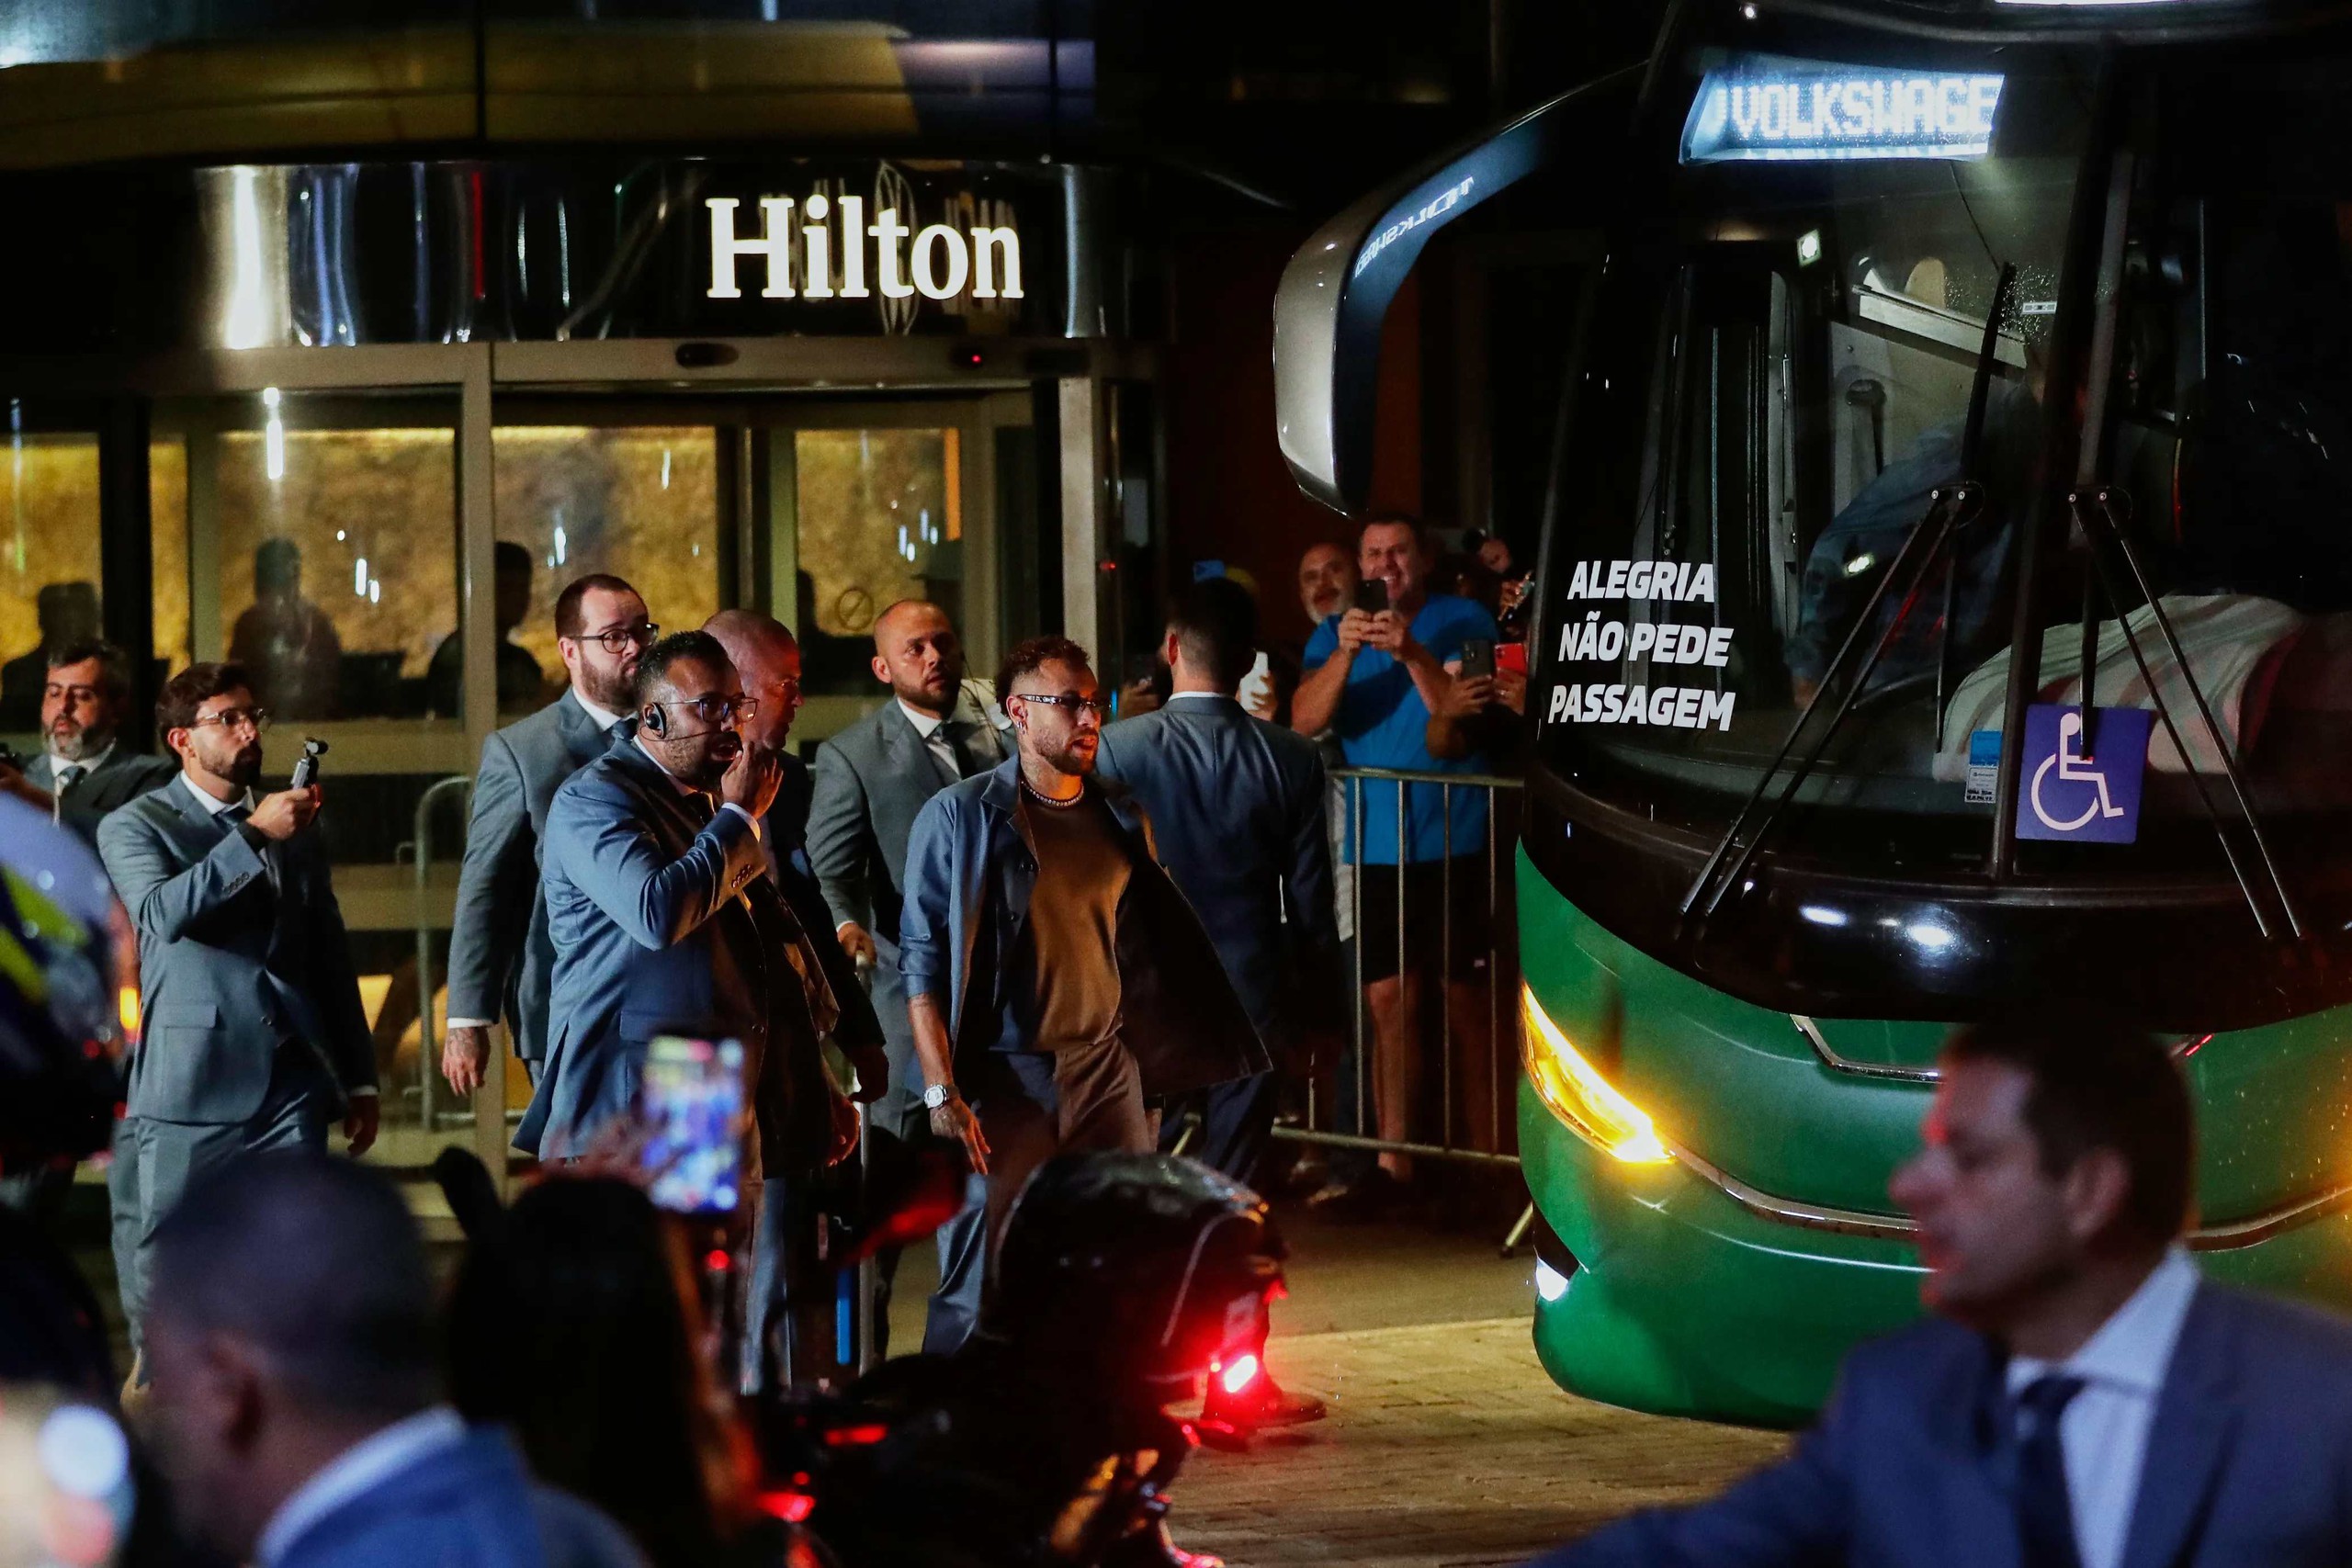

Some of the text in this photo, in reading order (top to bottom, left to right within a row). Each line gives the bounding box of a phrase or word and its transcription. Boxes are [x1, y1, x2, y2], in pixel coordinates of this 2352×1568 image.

[1731, 78, 2004, 137] VOLKSWAGE
[706, 194, 1024, 299] Hilton
[1566, 560, 1715, 603] ALEGRIA
[1558, 610, 1735, 667] NÃO PEDE
[1547, 683, 1736, 731] PASSAGEM
